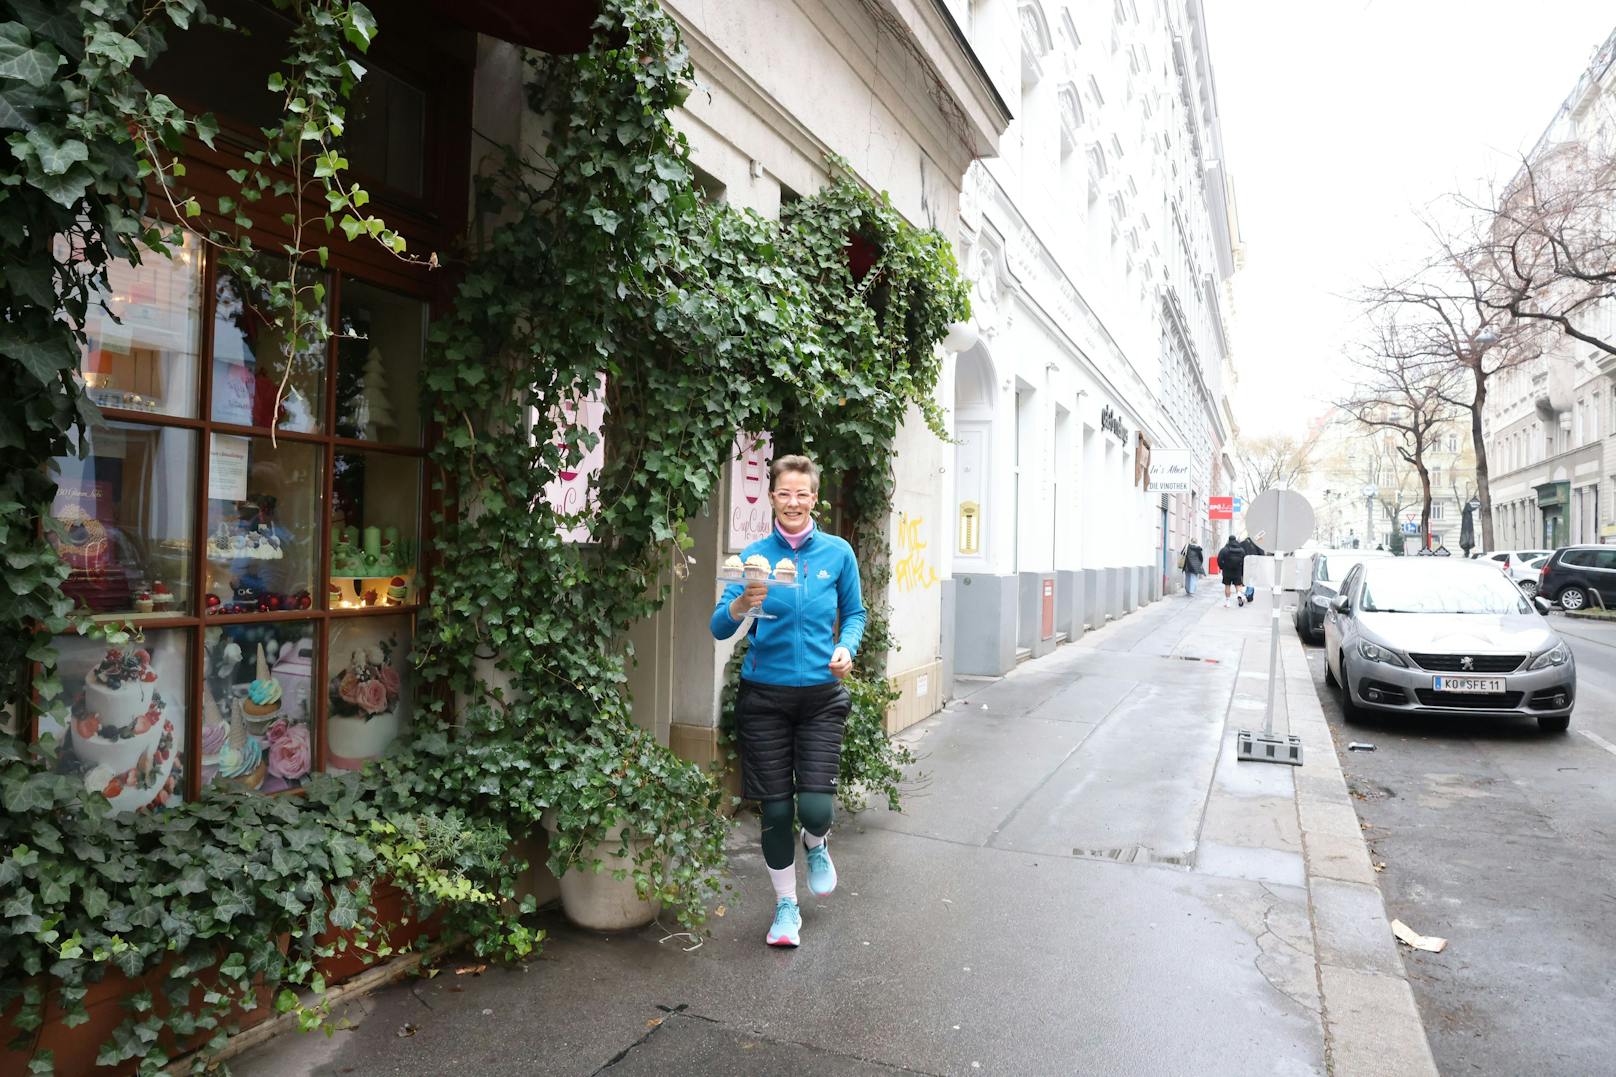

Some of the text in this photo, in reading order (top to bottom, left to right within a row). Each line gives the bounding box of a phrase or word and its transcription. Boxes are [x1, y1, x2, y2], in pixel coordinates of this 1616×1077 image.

[1149, 482, 1187, 490] DIE VINOTHEK
[1466, 680, 1487, 690] SFE
[1489, 680, 1500, 690] 11
